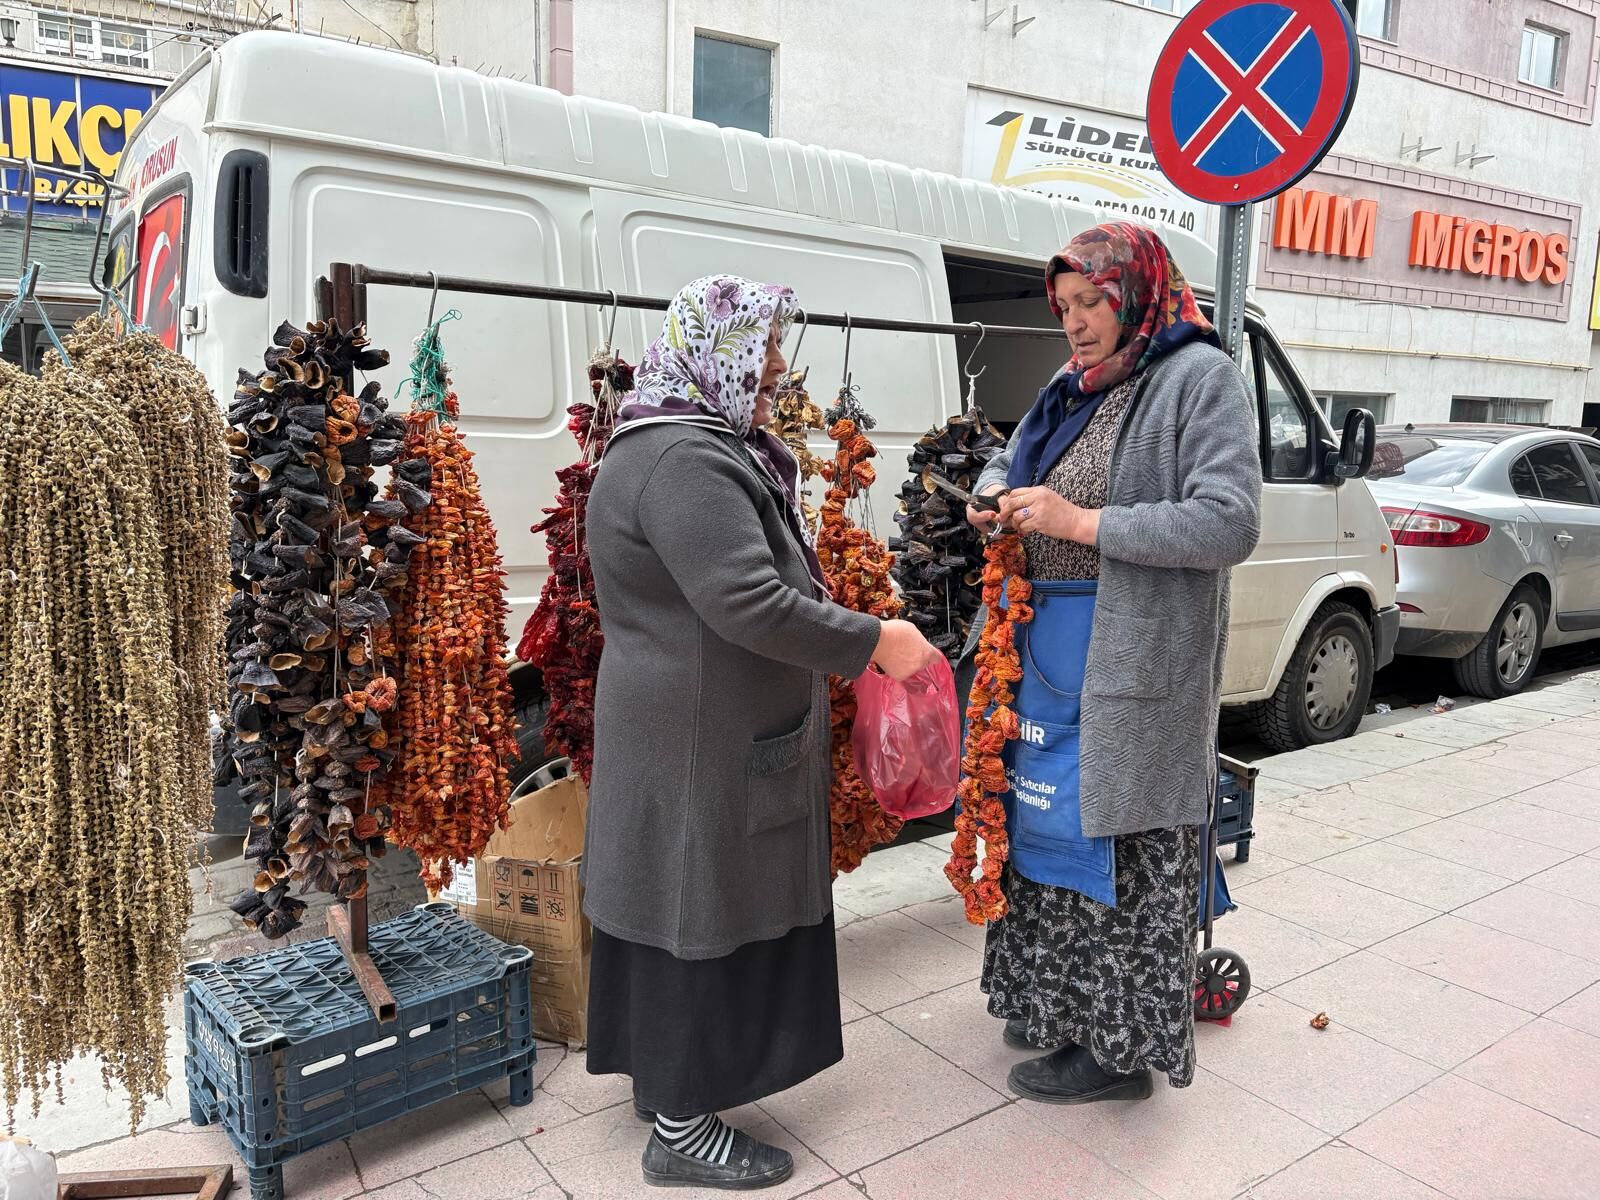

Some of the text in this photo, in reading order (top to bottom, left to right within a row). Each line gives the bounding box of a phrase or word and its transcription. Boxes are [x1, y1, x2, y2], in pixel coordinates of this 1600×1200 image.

[1024, 141, 1113, 164] SÜRÜCÜ
[1178, 211, 1195, 232] 40
[1273, 187, 1377, 258] MM
